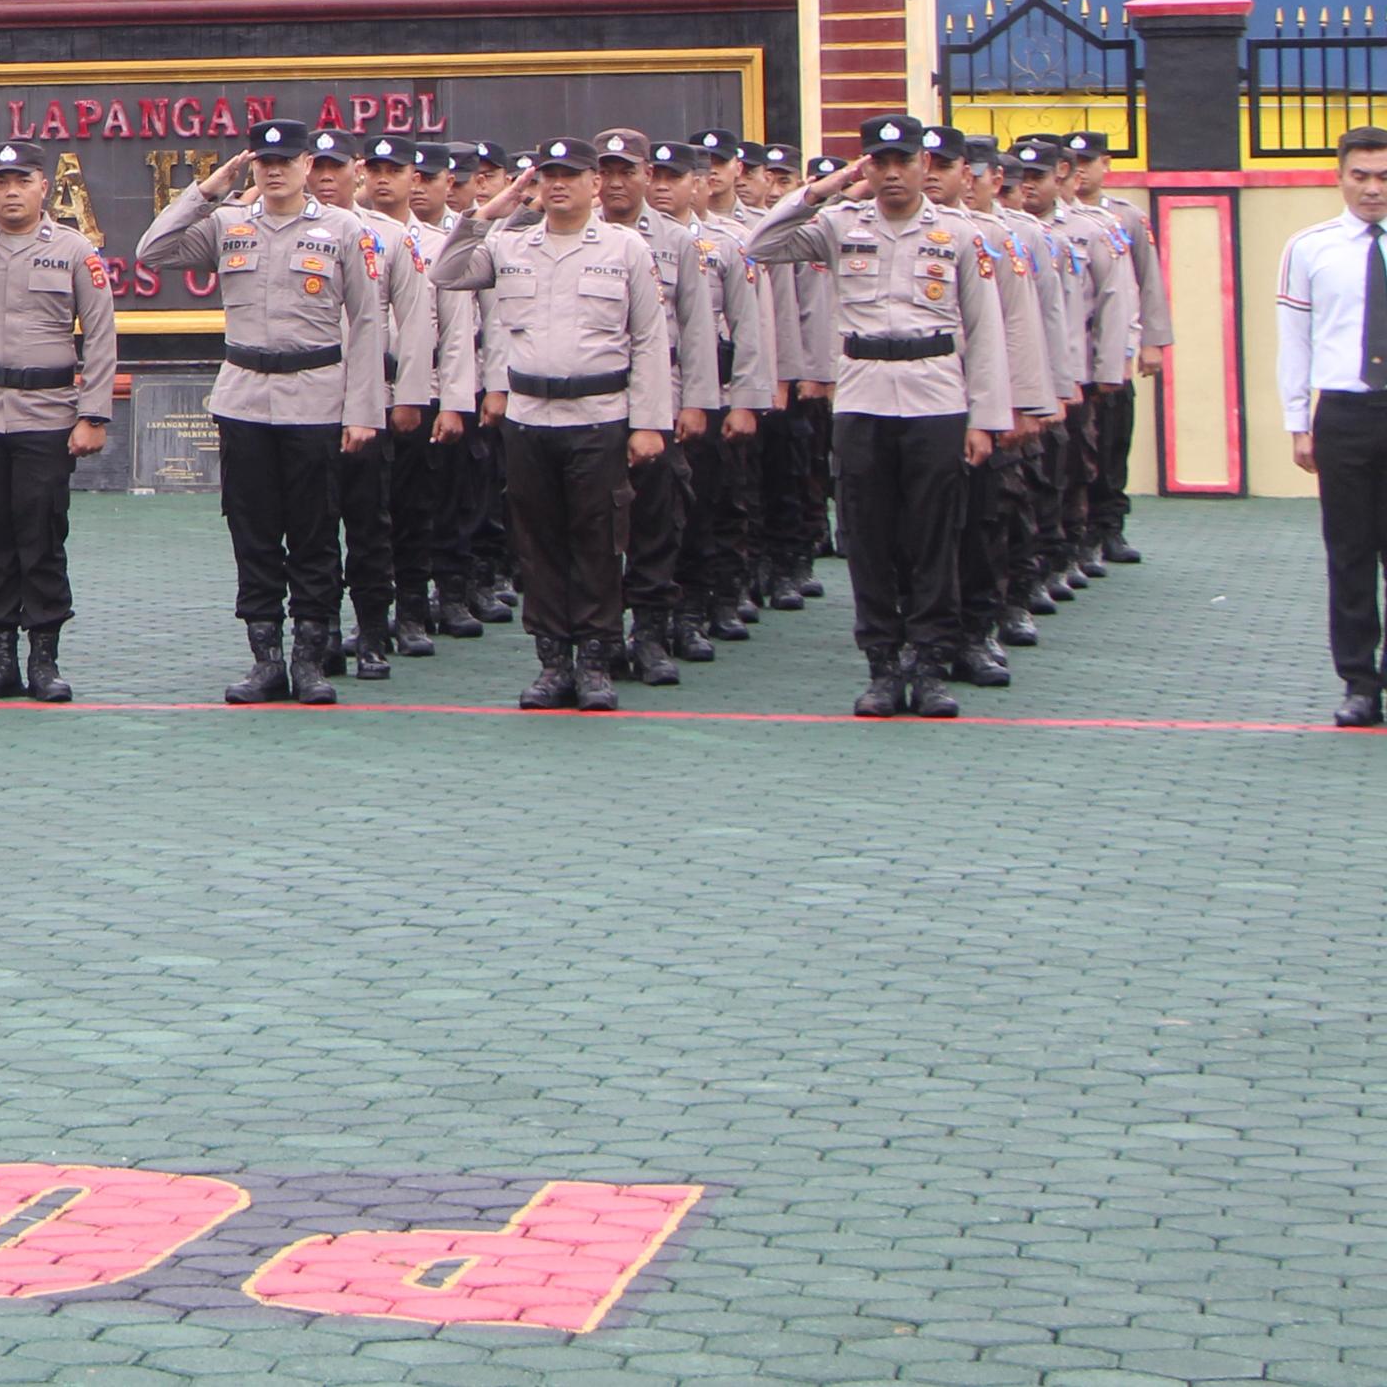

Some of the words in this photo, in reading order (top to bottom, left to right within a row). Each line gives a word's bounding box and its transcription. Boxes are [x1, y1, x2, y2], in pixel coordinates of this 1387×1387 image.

[8, 96, 276, 140] LAPANGAN
[316, 92, 448, 135] APEL
[297, 241, 337, 255] POLRI
[918, 246, 955, 260] POLRI
[33, 258, 69, 270] POLRI
[584, 266, 624, 277] POLRI
